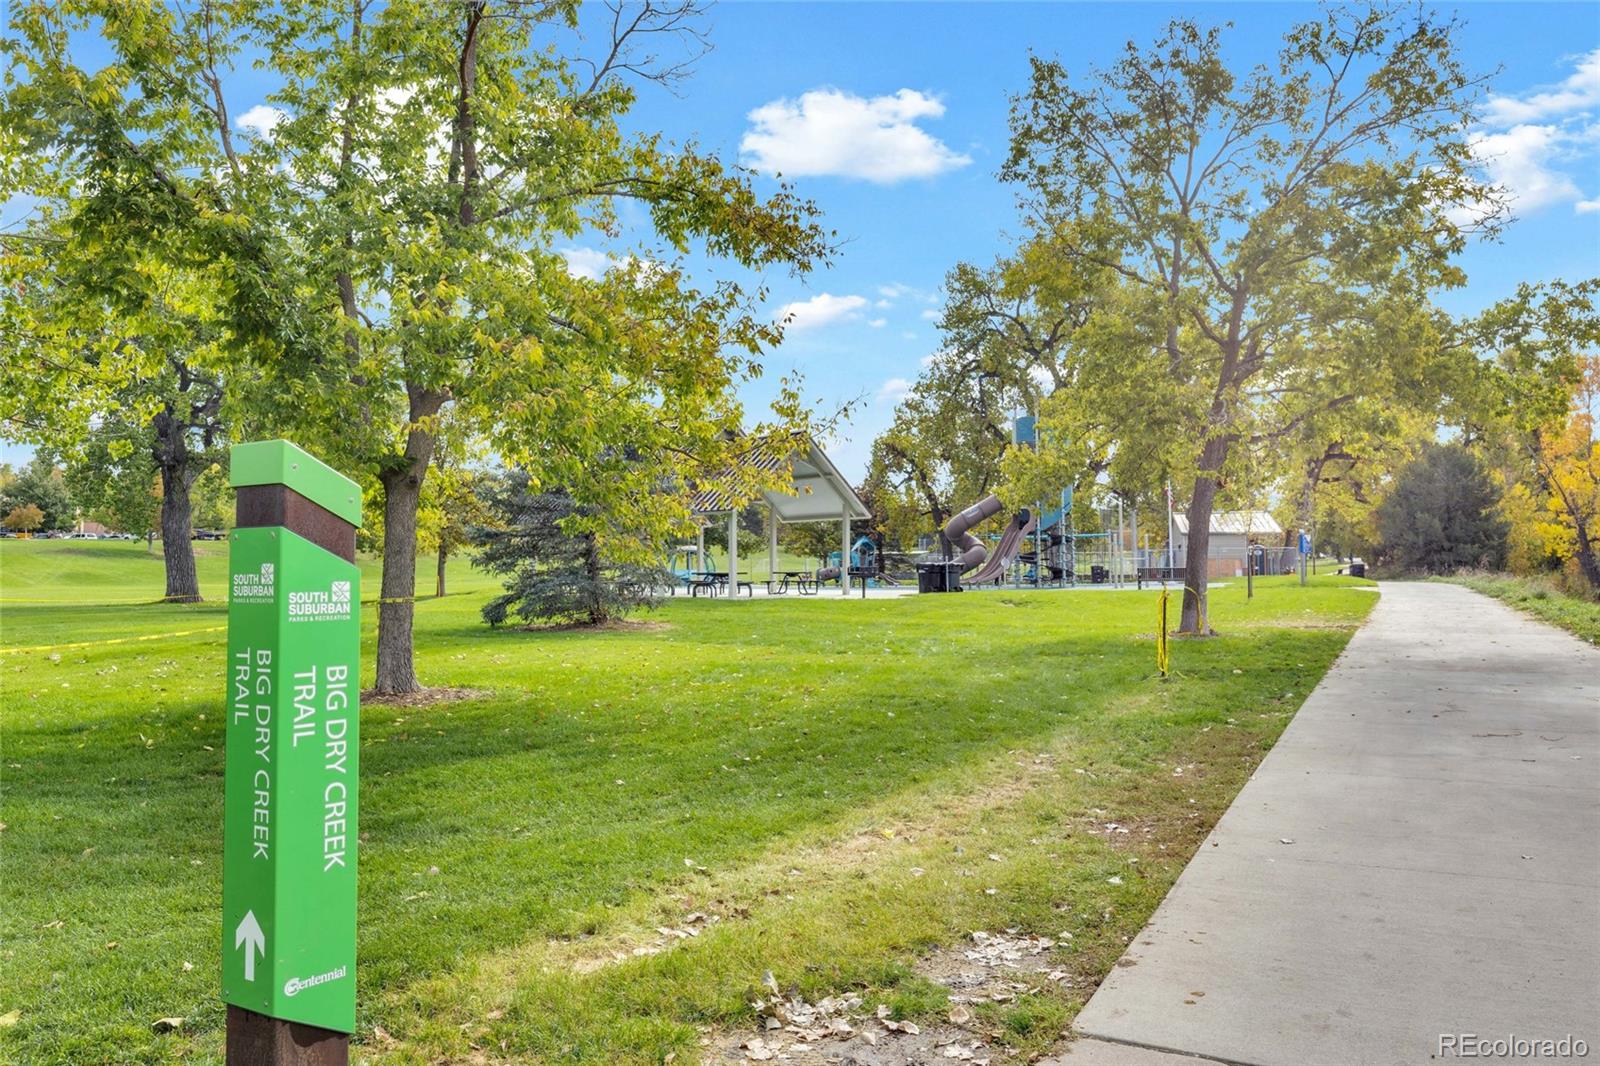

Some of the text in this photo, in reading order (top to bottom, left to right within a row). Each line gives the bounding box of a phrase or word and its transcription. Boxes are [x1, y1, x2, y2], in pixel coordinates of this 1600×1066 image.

[233, 574, 259, 585] SOUTH
[233, 585, 274, 597] SUBURBAN
[288, 592, 328, 603] SOUTH
[288, 603, 351, 615] SUBURBAN
[234, 647, 251, 725] TRAIL
[293, 665, 316, 747] TRAIL
[253, 650, 272, 860] BIG DRY CREEK
[323, 665, 348, 872] BIG DRY CREEK
[284, 965, 346, 997] Centennial
